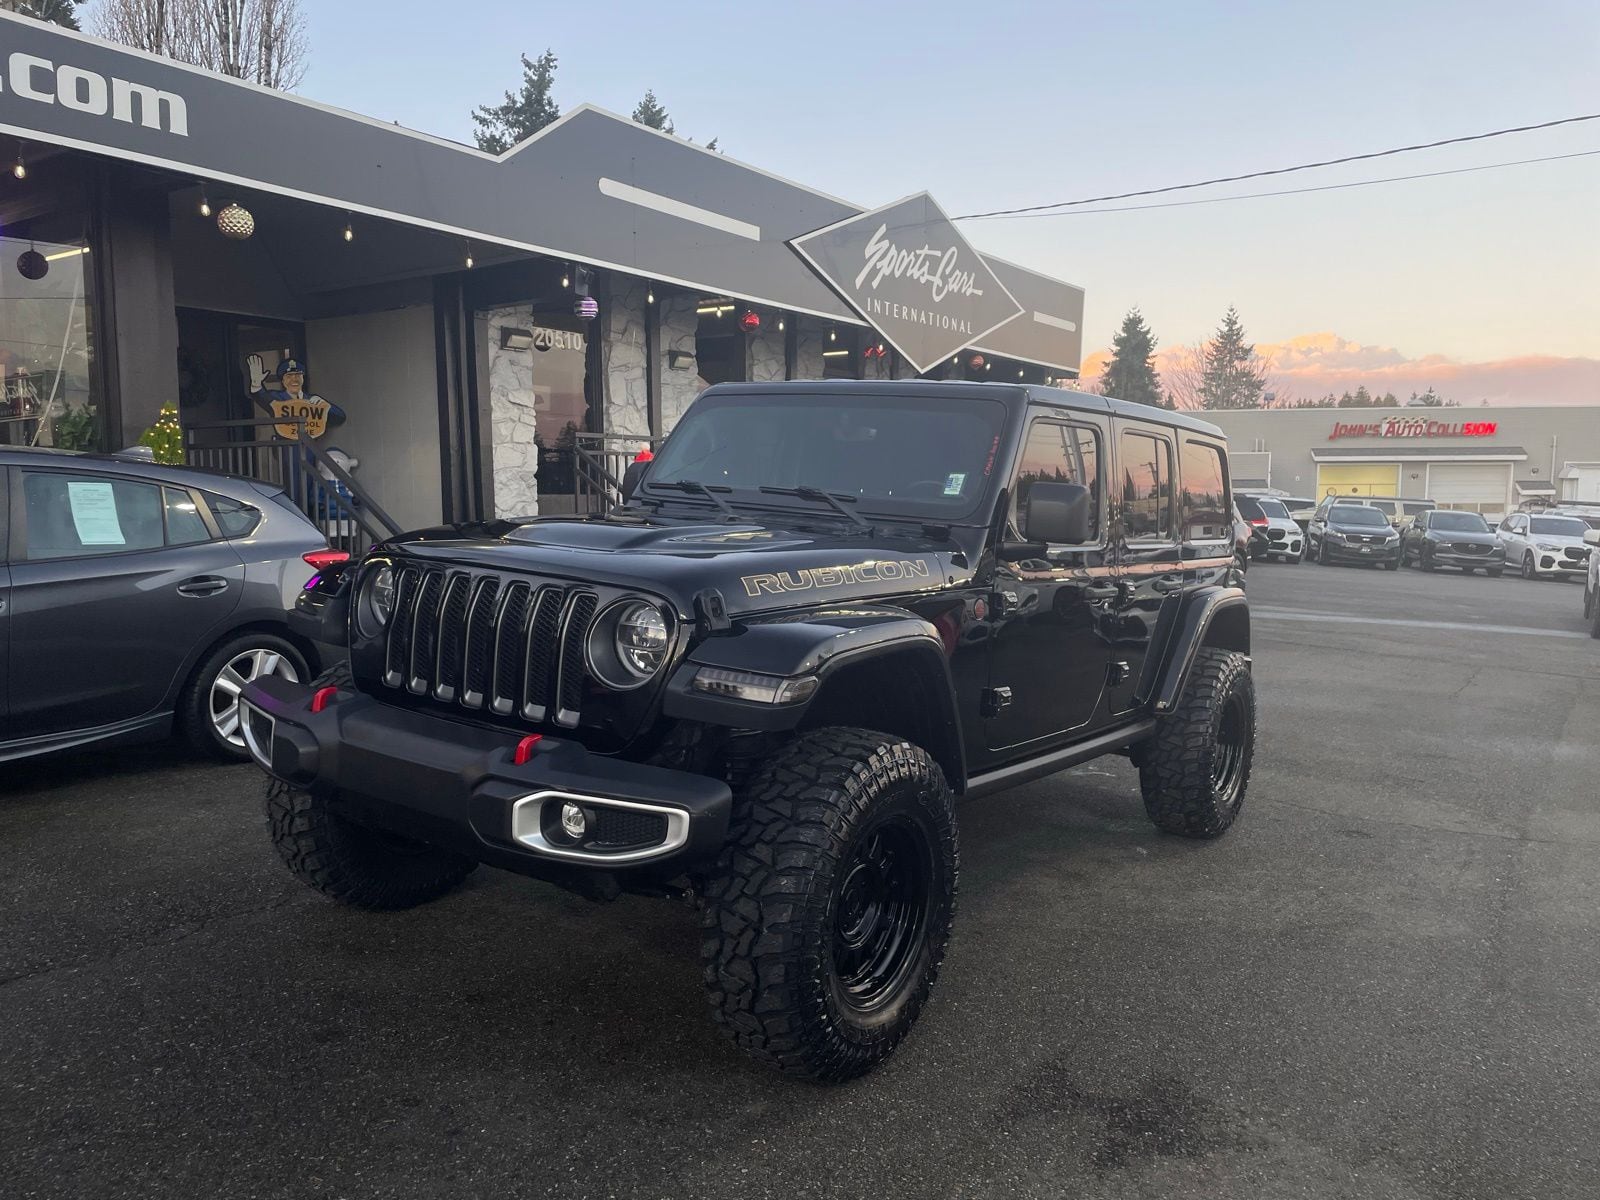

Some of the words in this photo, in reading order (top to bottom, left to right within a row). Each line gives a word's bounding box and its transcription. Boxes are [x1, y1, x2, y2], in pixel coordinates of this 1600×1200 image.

[0, 52, 189, 137] com
[855, 223, 941, 290] Sports
[932, 246, 983, 302] Cars
[867, 297, 973, 335] INTERNATIONAL
[535, 328, 582, 350] 20510
[281, 405, 324, 420] SLOW
[1328, 422, 1380, 441] JOHN'S
[1385, 421, 1425, 437] AUTO
[1426, 421, 1498, 438] COLLISION
[740, 559, 930, 597] RUBICON
